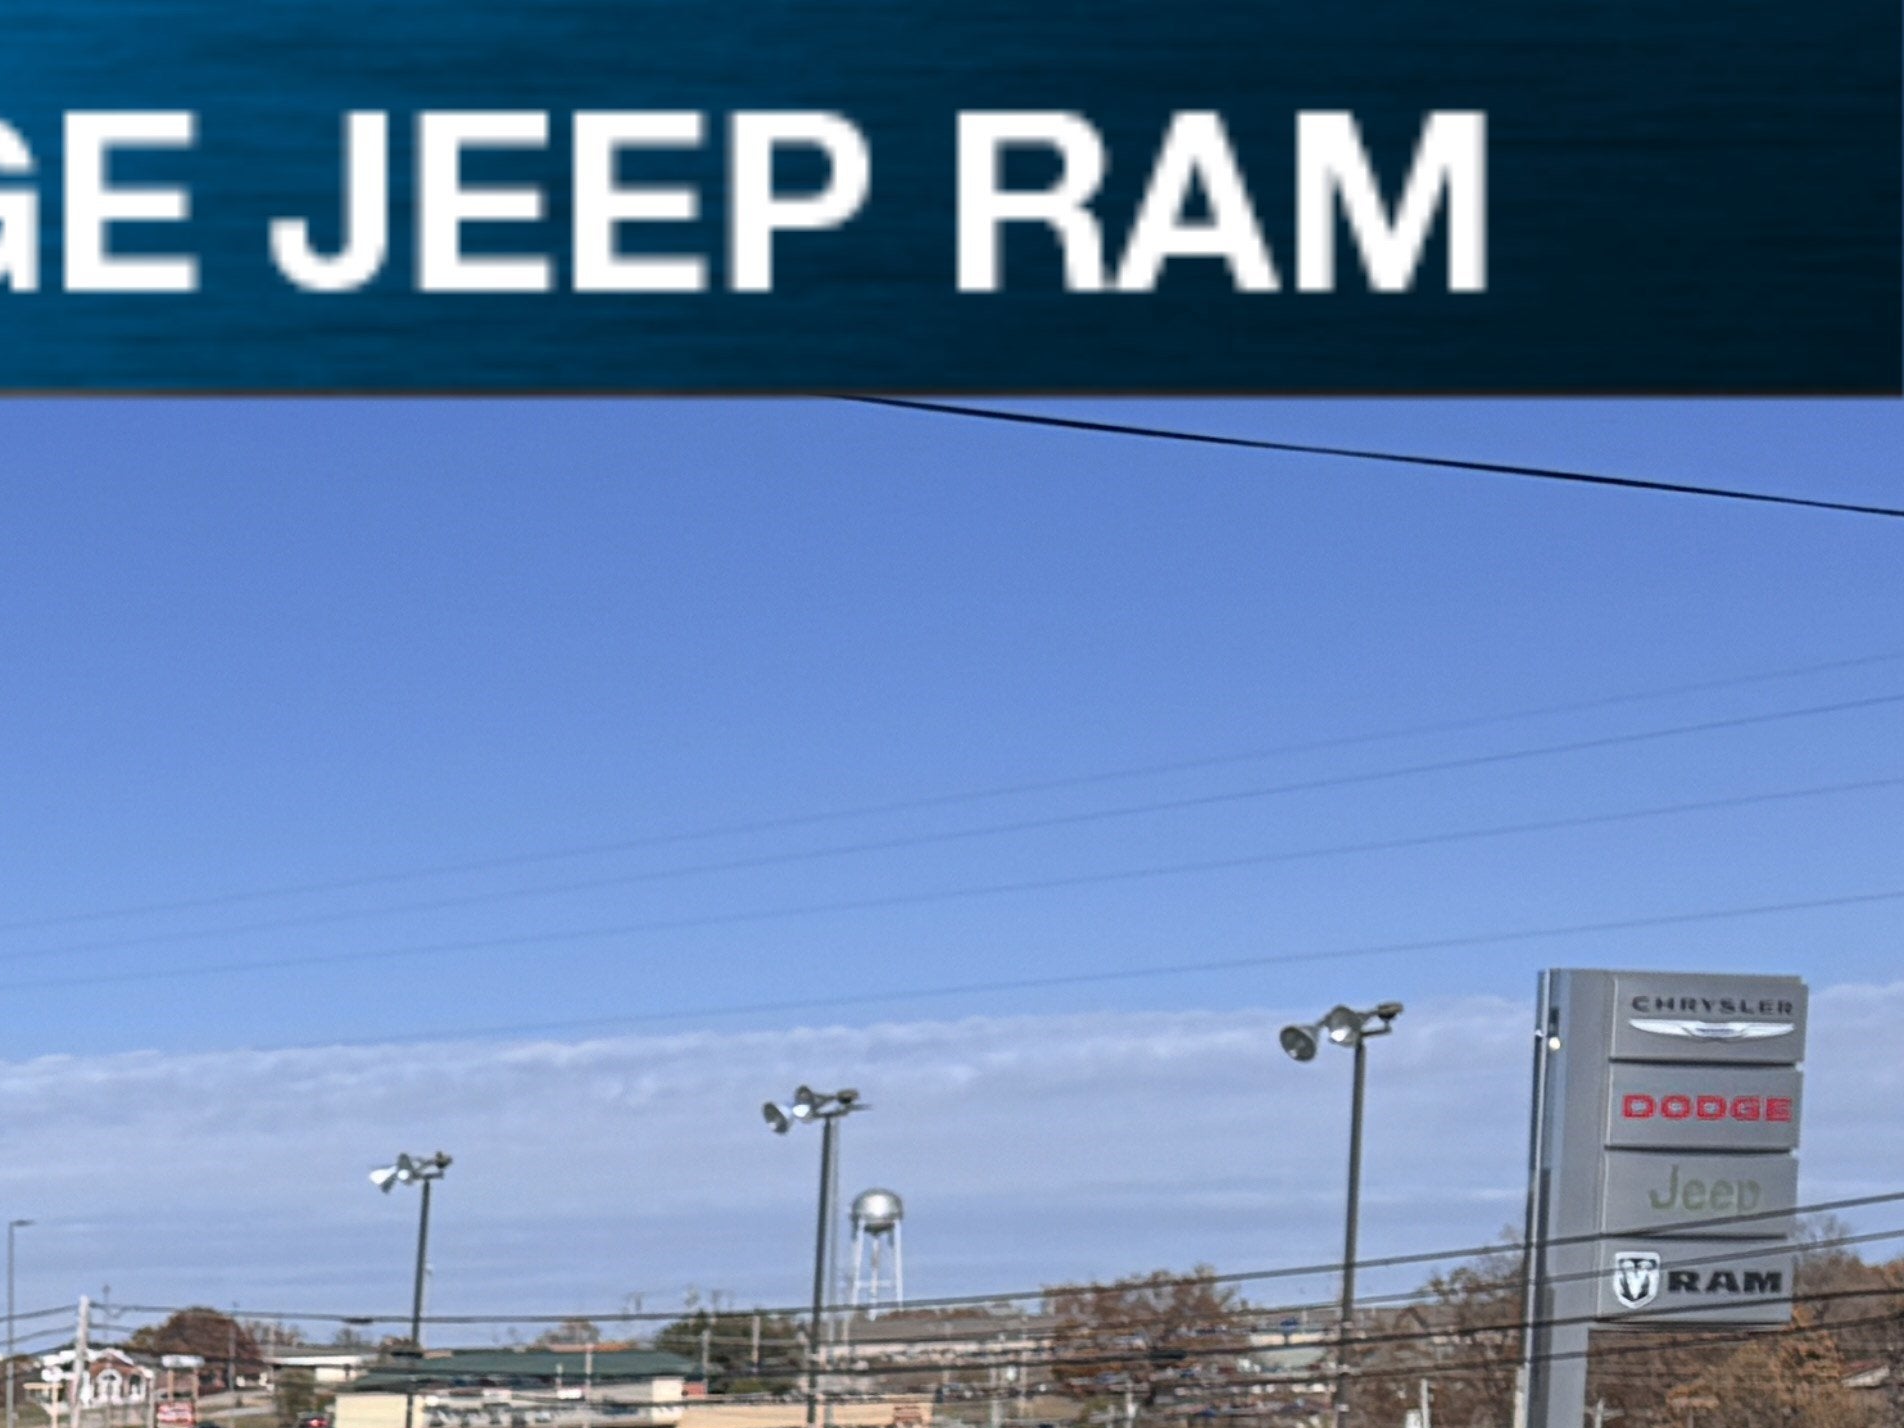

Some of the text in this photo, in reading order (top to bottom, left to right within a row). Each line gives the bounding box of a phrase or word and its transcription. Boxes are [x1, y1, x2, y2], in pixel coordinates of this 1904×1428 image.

[1631, 994, 1794, 1017] CHRYSLER
[1621, 1093, 1793, 1123] DODGE
[1649, 1163, 1761, 1216] Jeep
[1667, 1267, 1783, 1295] RAM
